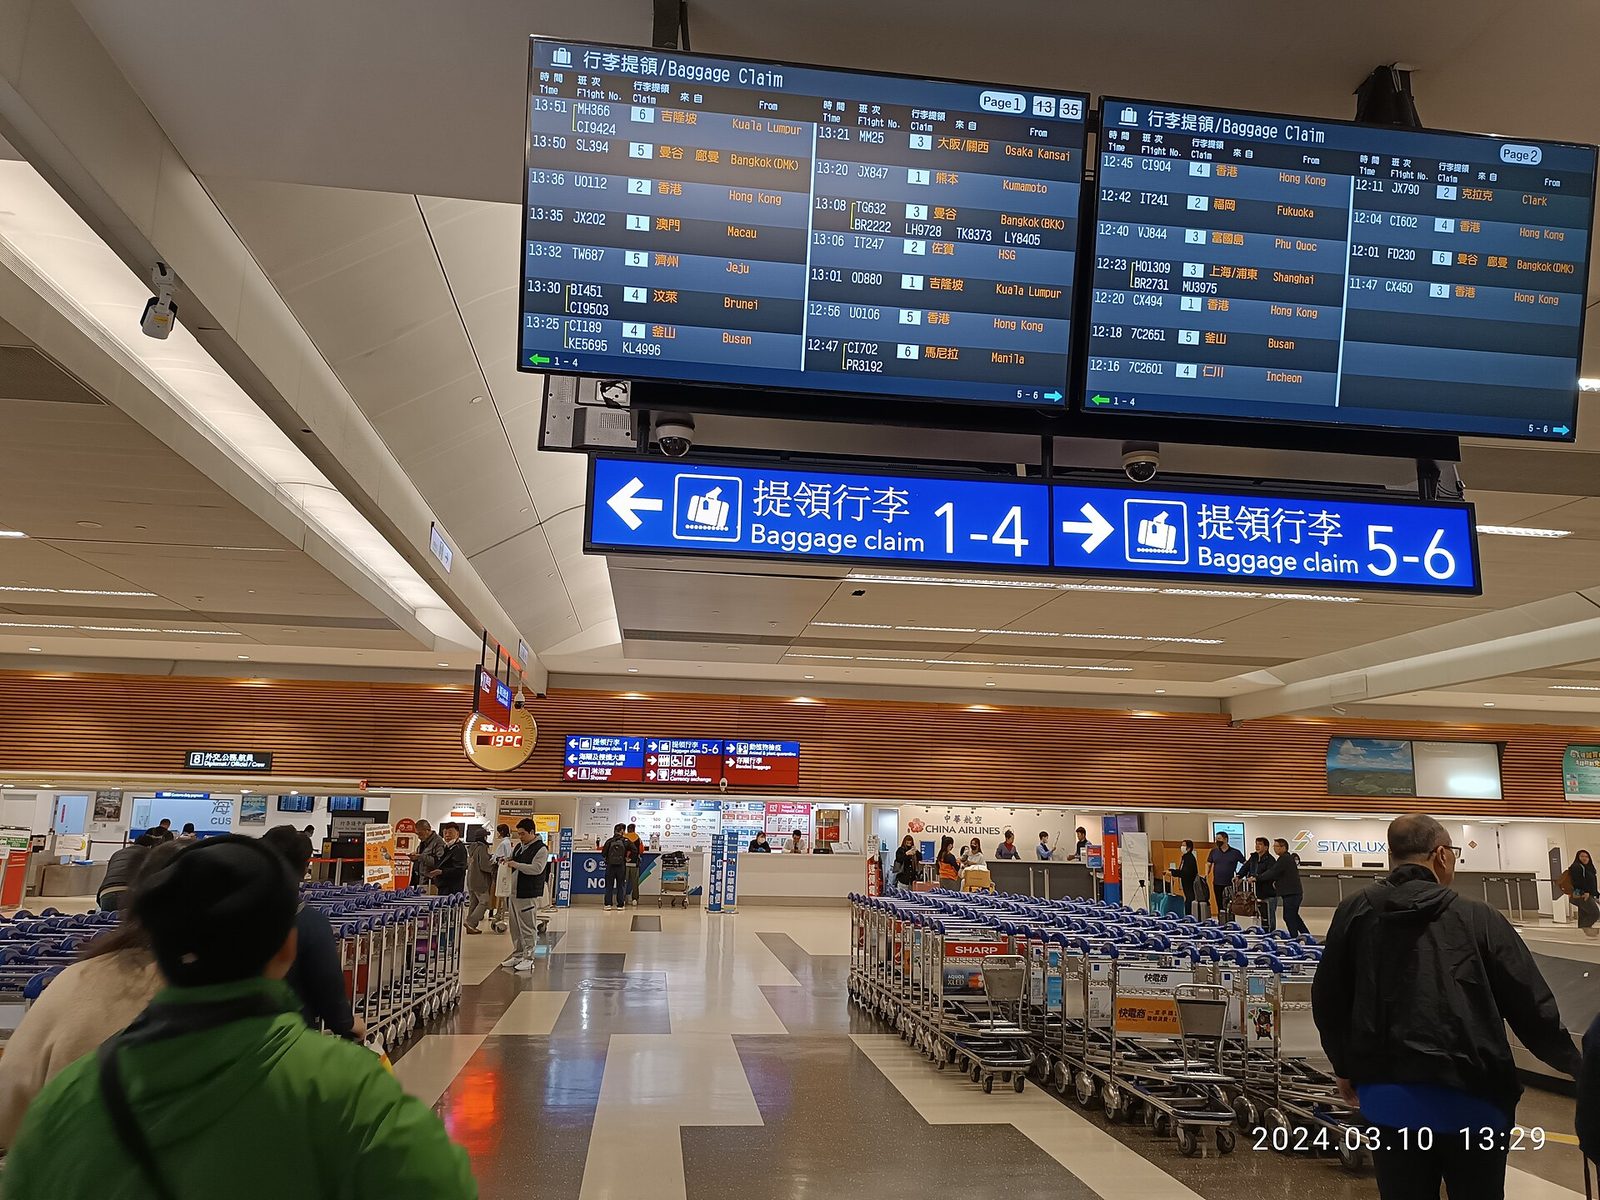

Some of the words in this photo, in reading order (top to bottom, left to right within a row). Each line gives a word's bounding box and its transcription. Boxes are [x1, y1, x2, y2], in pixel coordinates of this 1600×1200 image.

[584, 51, 730, 82] 行李提領/Baggage
[739, 69, 783, 88] Claim
[535, 99, 567, 113] 13:51
[578, 103, 610, 116] MH366
[661, 111, 697, 125] 吉隆坡
[732, 119, 762, 131] Kuala
[767, 122, 802, 135] Lumpur
[1036, 99, 1052, 113] 13
[1062, 103, 1078, 115] 35
[577, 121, 616, 135] CI9424
[1148, 111, 1278, 139] 行李提領/Baggage
[1285, 126, 1325, 143] Claim
[533, 135, 566, 149] 13:50
[576, 140, 608, 152] SL394
[659, 147, 683, 159] 曼谷
[730, 154, 798, 170] Bangkok(DMK)
[819, 126, 850, 141] 13:21
[859, 131, 884, 144] MM25
[938, 138, 988, 153] 大阪/關西
[1005, 144, 1034, 158] Osaka
[1038, 148, 1070, 161] Kansai
[817, 162, 848, 176] 13:20
[858, 166, 888, 179] JX847
[936, 172, 958, 185] 熊本
[1003, 180, 1048, 194] Kumamoto
[1104, 156, 1133, 168] 12:45
[1142, 160, 1171, 172] CI904
[1216, 165, 1238, 178] 香港
[1279, 173, 1300, 184] Hong
[1305, 175, 1326, 187] Kong
[1102, 190, 1131, 203] 12:42
[1140, 193, 1168, 206] IT241
[1214, 198, 1235, 211] 福岡
[1277, 206, 1314, 218] Fukuoka
[1356, 180, 1383, 192] 12:11
[1392, 183, 1419, 195] JX790
[1462, 188, 1492, 201] 克拉克
[1522, 195, 1547, 206] Clark
[530, 208, 563, 222] 13:35
[573, 211, 605, 226] JX202
[656, 218, 680, 231] 澳門
[728, 226, 756, 239] Macau
[816, 198, 846, 211] 13:08
[856, 201, 886, 215] TG632
[934, 207, 957, 220] 曼谷
[1001, 215, 1064, 231] Bangkok(BKK)
[855, 218, 891, 233] BR2222
[905, 222, 941, 237] LH9728
[956, 227, 992, 241] TK8373
[1005, 231, 1040, 245] LY8405
[1100, 224, 1129, 237] 12:40
[1138, 227, 1167, 239] VJ844
[1275, 239, 1291, 249] Phu
[1296, 241, 1317, 252] Quoc
[529, 244, 561, 258] 13:32
[572, 248, 604, 261] TW687
[726, 262, 749, 275] Jeju
[814, 233, 844, 246] 13:06
[854, 237, 884, 250] IT247
[932, 242, 954, 255] 佐賀
[999, 250, 1015, 259] HSG
[812, 269, 842, 282] 13:01
[930, 278, 963, 291] 吉隆坡
[996, 284, 1024, 296] Kuala
[1028, 287, 1061, 299] Lumpur
[1097, 258, 1126, 270] 12:23
[1210, 266, 1258, 280] 上海/浦東
[1273, 272, 1314, 285] Shanghai
[527, 281, 560, 294] 13:30
[570, 284, 602, 298] BI451
[653, 290, 677, 303] 汶萊
[724, 298, 759, 310] Brunei
[1134, 278, 1168, 290] BR2731
[1183, 281, 1217, 294] MU3975
[570, 302, 609, 316] CI9503
[526, 317, 559, 330] 13:25
[569, 320, 602, 333] CI189
[652, 326, 675, 339] 釜山
[723, 333, 752, 345] Busan
[1093, 326, 1122, 338] 12:18
[1131, 328, 1165, 341] 7C2651
[1205, 333, 1226, 345] 釜山
[1268, 339, 1294, 350] Busan
[569, 338, 607, 352] KE5695
[623, 341, 660, 356] KL4996
[808, 339, 838, 351] 12:47
[848, 342, 878, 355] CI702
[924, 347, 958, 360] 馬尼拉
[991, 352, 1024, 364] Manila
[846, 359, 882, 373] PR3192
[1090, 359, 1120, 372] 12:16
[1129, 362, 1163, 375] 7C2601
[1203, 366, 1224, 378] 仁川
[1266, 372, 1302, 383] Incheon
[753, 480, 910, 523] 提領行李
[934, 502, 1028, 557] 1-4
[1197, 504, 1343, 546] 提領行李
[751, 525, 857, 554] Baggage
[864, 529, 924, 553] claim
[1367, 525, 1456, 580] 5-6
[1198, 546, 1296, 576] Baggage
[1303, 552, 1359, 574] claim
[194, 755, 200, 763] 8
[623, 742, 640, 751] 1-4
[702, 744, 718, 754] 5-6
[925, 825, 956, 833] CHINA
[958, 826, 1000, 834] AIRLINES
[944, 815, 982, 824] 中華航空
[1317, 841, 1386, 852] STARLUX
